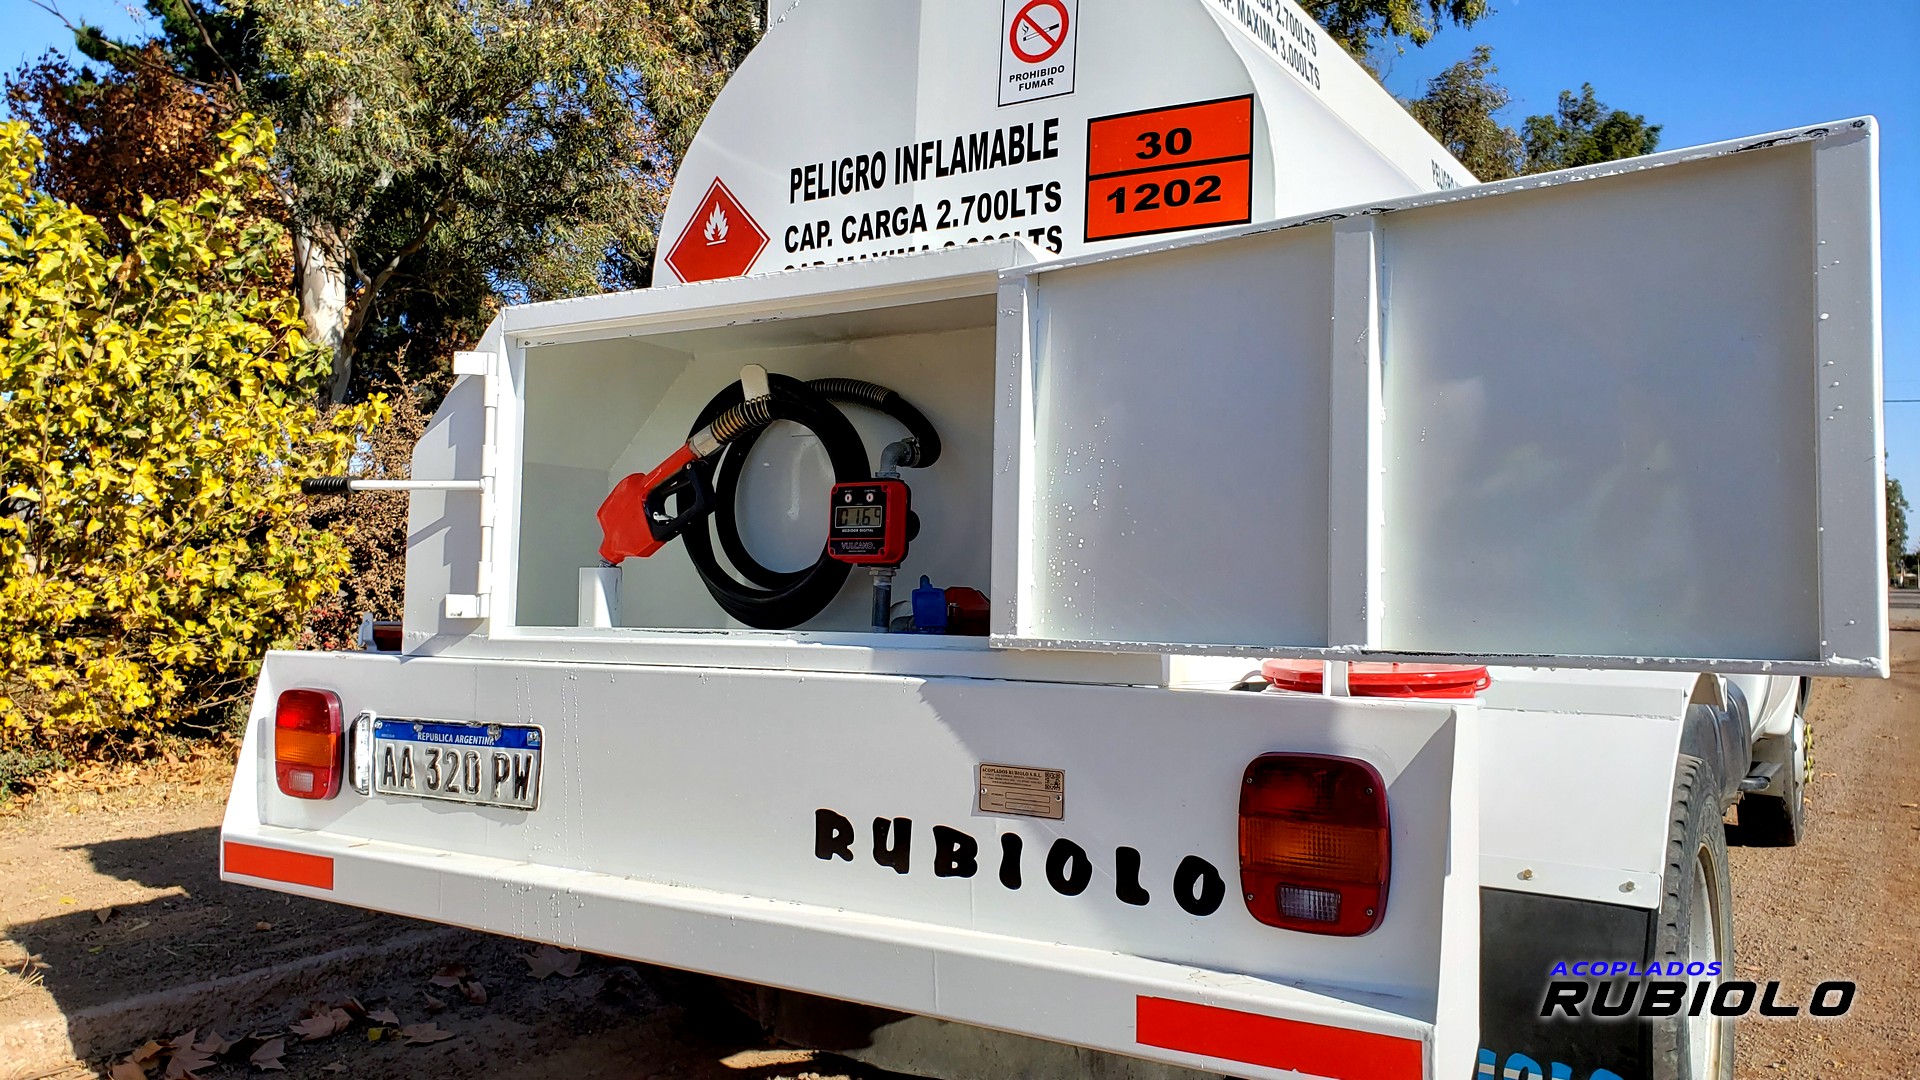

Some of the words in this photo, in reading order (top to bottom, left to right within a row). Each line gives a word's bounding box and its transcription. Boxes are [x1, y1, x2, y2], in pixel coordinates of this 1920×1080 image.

[1237, 0, 1279, 55] MAXIMA
[1280, 35, 1321, 91] 3.000LTS
[1275, 0, 1317, 57] 2.700LTS
[1008, 64, 1065, 83] PROHIBIDO
[1018, 77, 1054, 92] FUMAR
[789, 150, 887, 204] PELIGRO
[894, 117, 1059, 185] INFLAMABLE
[1135, 127, 1192, 160] 30
[784, 219, 833, 254] CAP.
[841, 203, 928, 244] CARGA
[936, 180, 1062, 230] 2.700LTS
[1106, 174, 1222, 214] 1202
[417, 731, 454, 743] REPUBLICA
[454, 734, 495, 746] ARGENTINA
[382, 743, 417, 789] AA
[424, 746, 482, 795] 320
[492, 751, 534, 801] PW
[814, 808, 1226, 916] RUBIOLO
